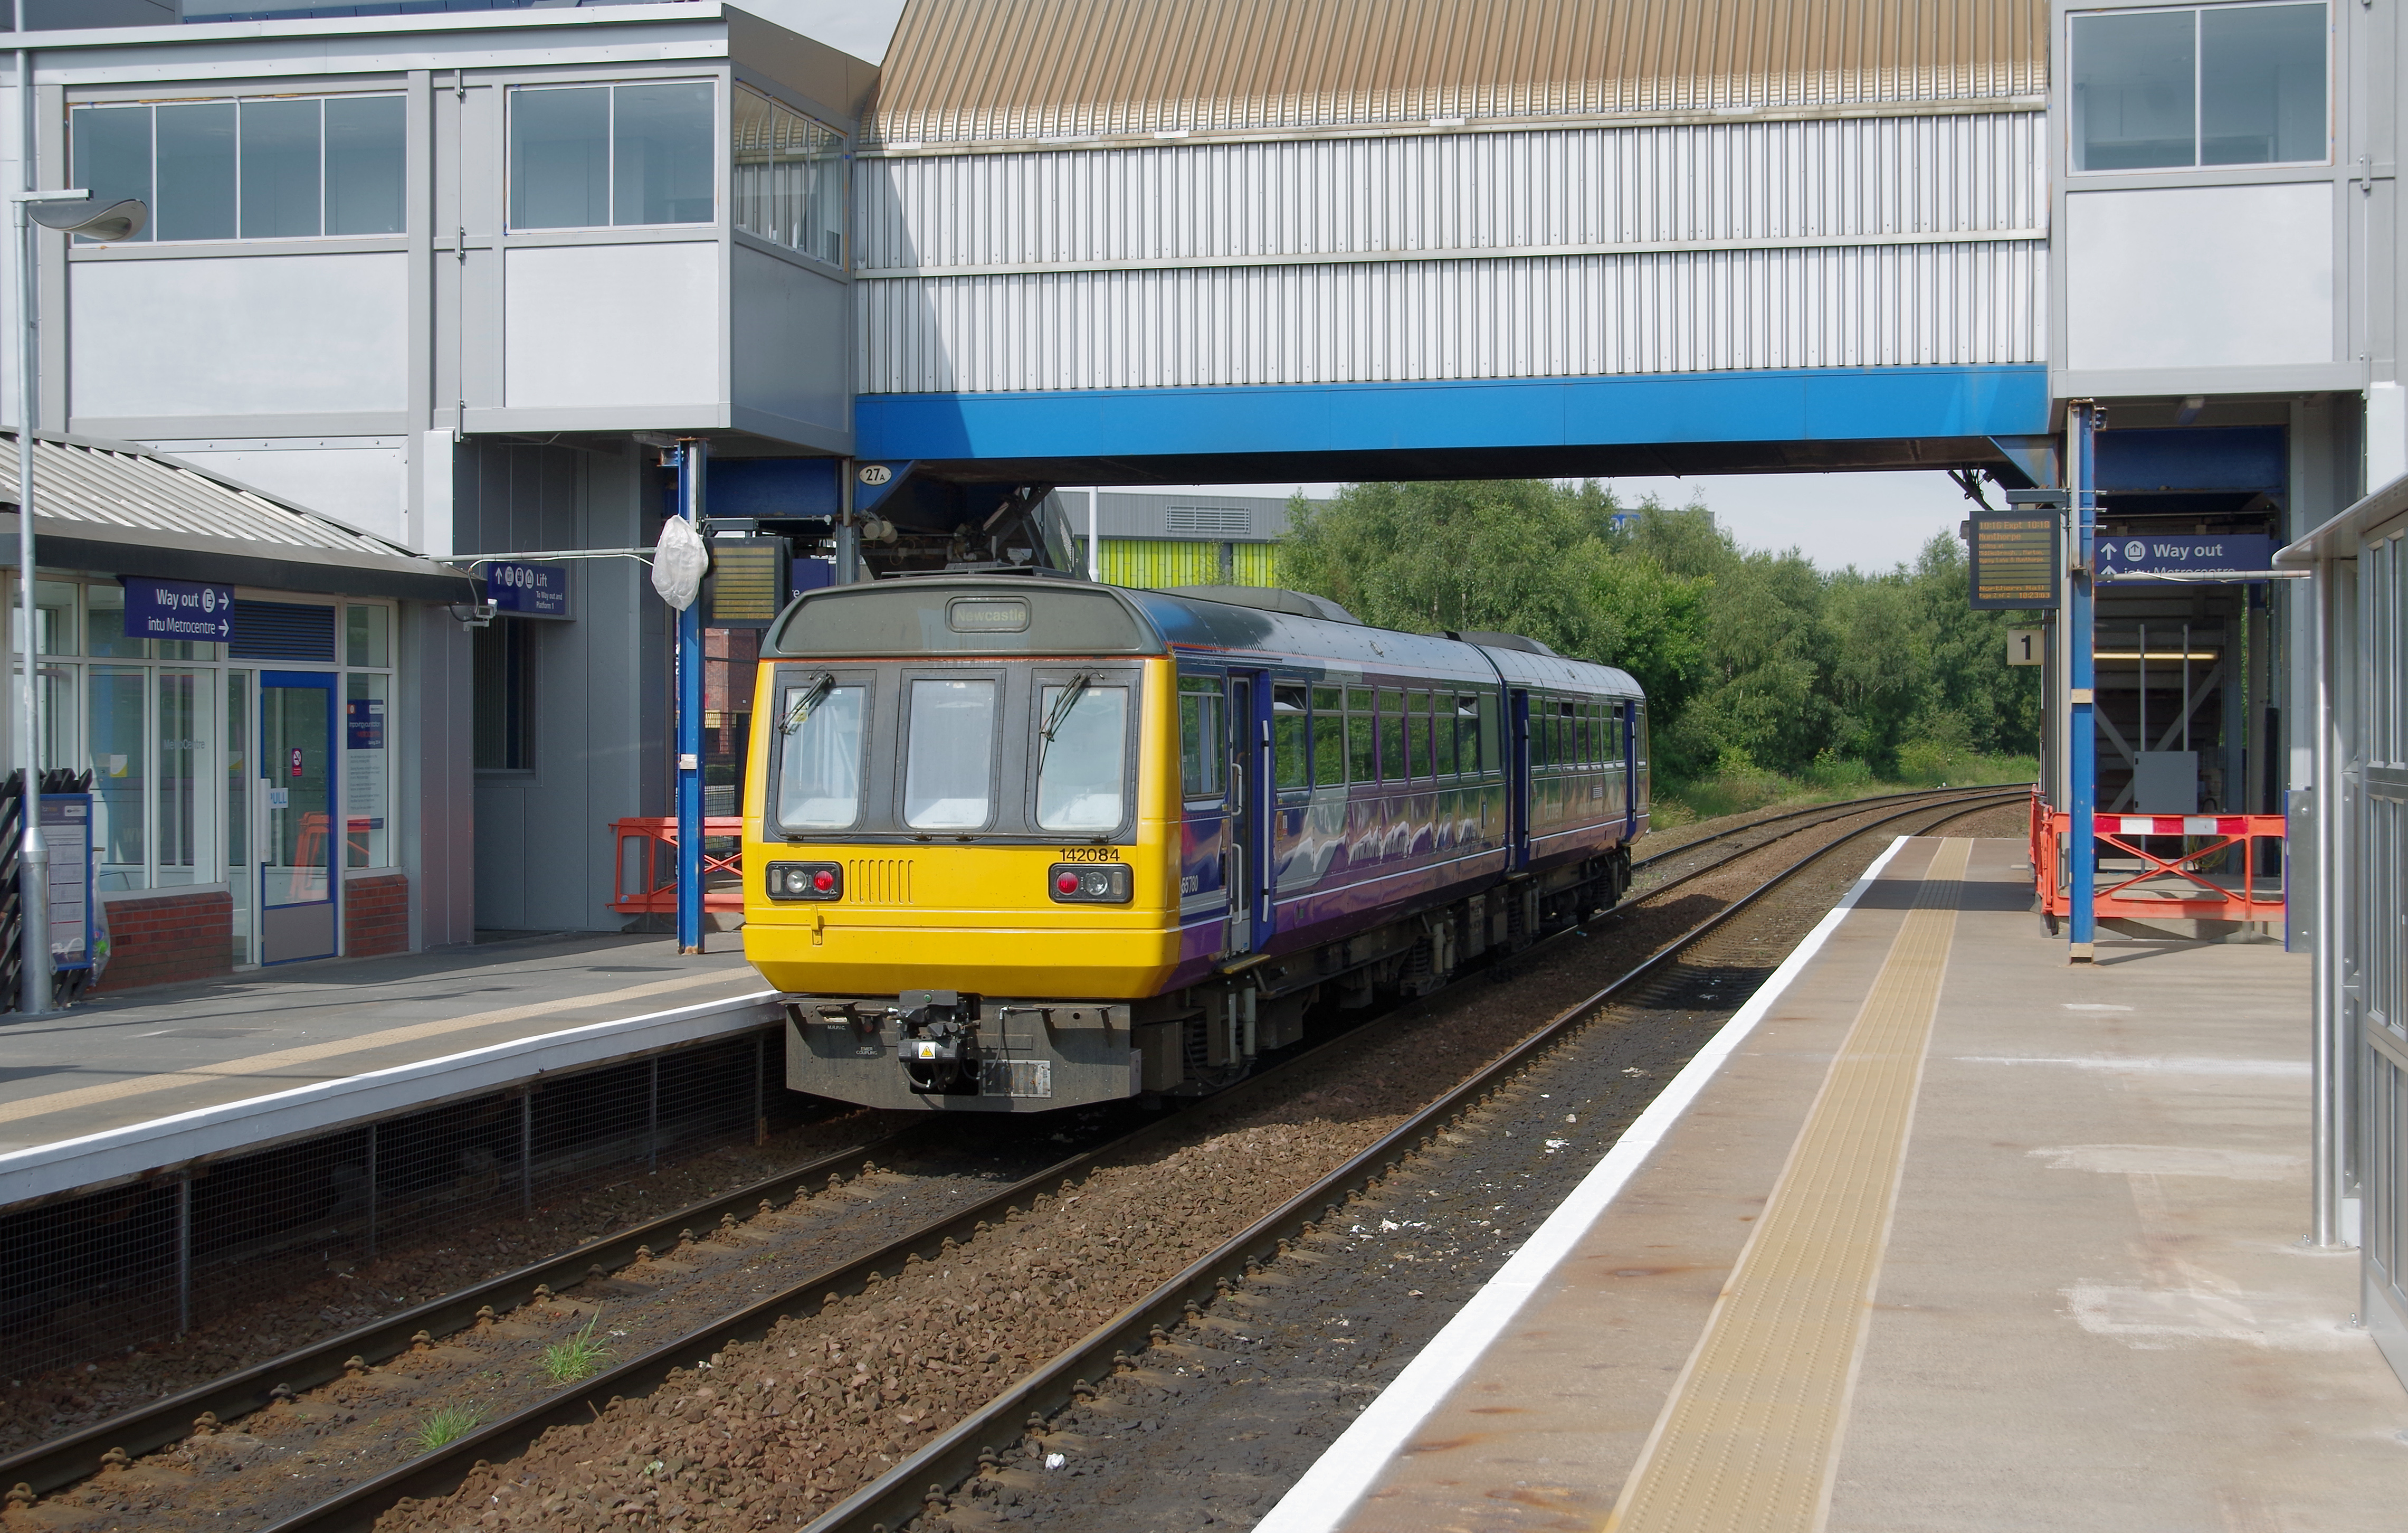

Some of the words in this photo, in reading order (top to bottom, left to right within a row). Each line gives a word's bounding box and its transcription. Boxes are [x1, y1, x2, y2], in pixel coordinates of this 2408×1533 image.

[866, 468, 885, 481] 27A
[2153, 544, 2189, 560] Way
[2194, 544, 2222, 556] out
[537, 573, 547, 586] Lift
[156, 589, 178, 610] Way
[182, 593, 198, 607] out
[956, 609, 1026, 621] Newcastle
[148, 616, 165, 631] intu
[167, 617, 215, 634] Metrocentre
[2021, 635, 2031, 660] 1
[1059, 848, 1120, 862] 142084
[1182, 875, 1198, 894] 55780
